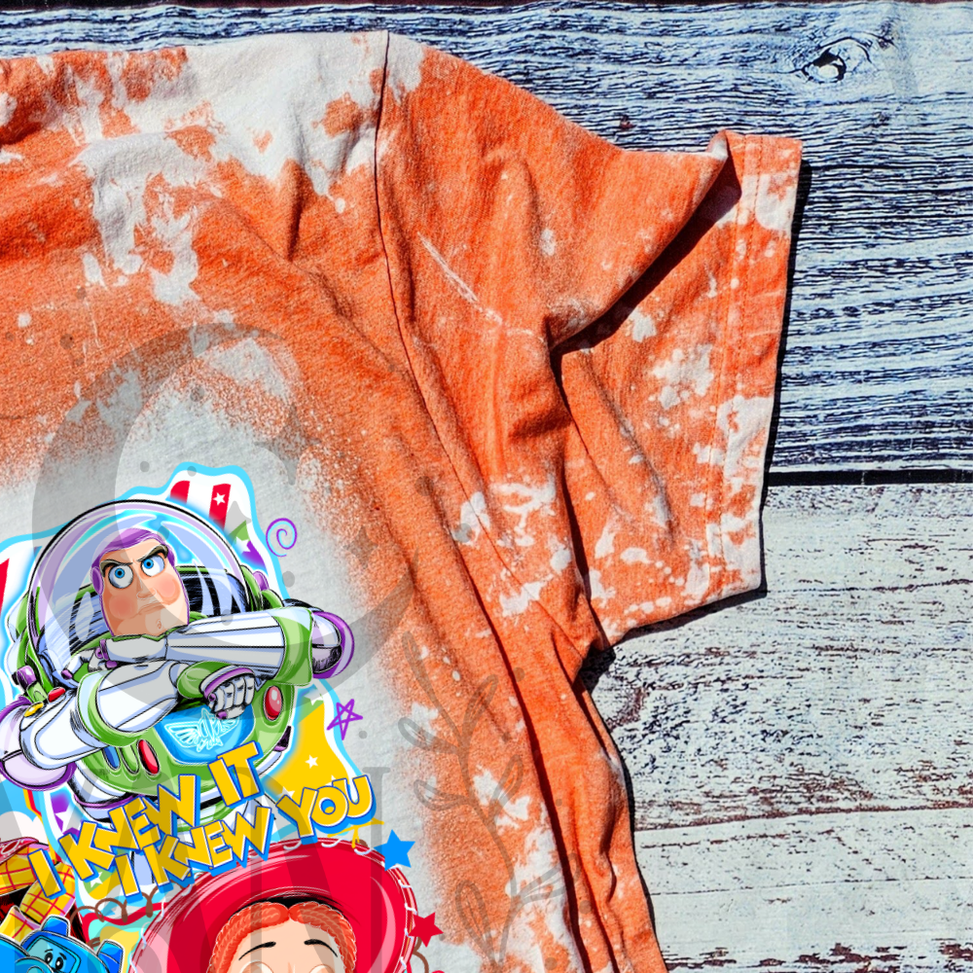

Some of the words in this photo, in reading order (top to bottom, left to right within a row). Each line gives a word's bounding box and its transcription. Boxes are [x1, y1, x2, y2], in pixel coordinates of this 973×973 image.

[28, 848, 66, 898] I
[58, 774, 201, 882] KNEW
[208, 741, 265, 808] IT
[115, 854, 142, 900] I
[143, 805, 275, 892] KNEW
[276, 775, 376, 843] YOU
